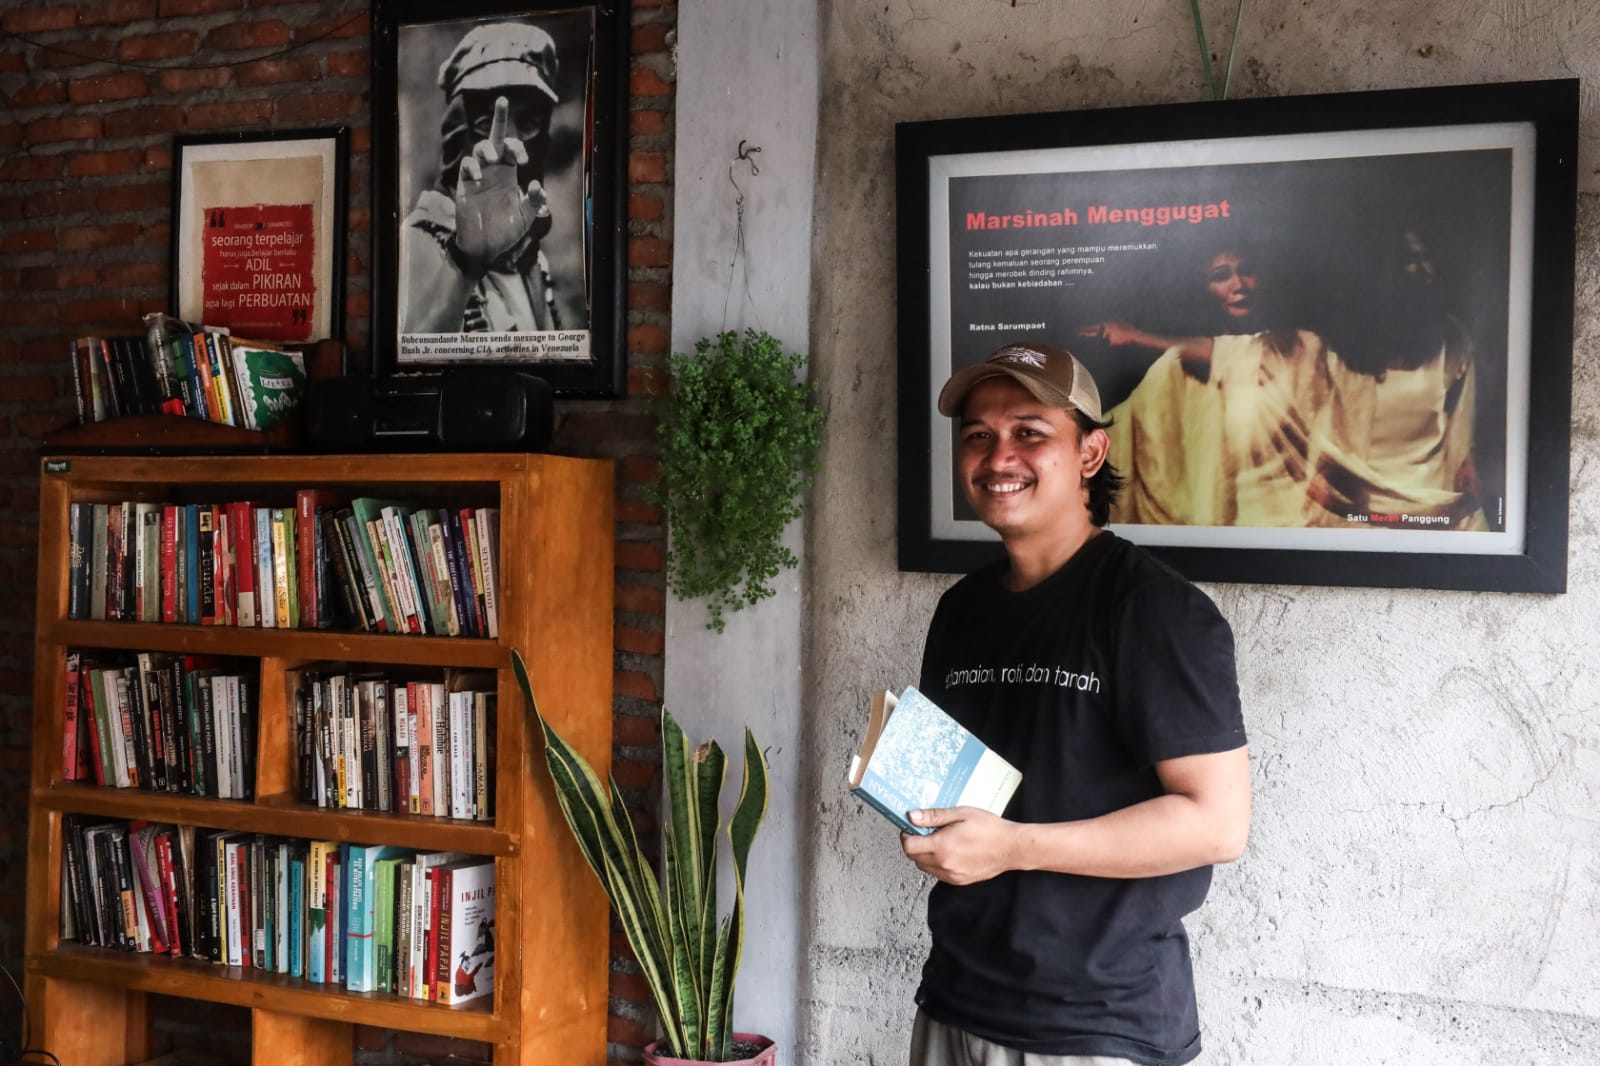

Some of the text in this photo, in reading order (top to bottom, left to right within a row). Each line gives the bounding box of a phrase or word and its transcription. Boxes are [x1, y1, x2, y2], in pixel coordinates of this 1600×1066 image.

[966, 199, 1231, 231] Marsinah Menggugat
[211, 232, 304, 248] seorang terpelajar
[969, 249, 1003, 258] Kekuatan
[1005, 249, 1019, 258] apa
[1057, 247, 1075, 255] yang
[1077, 245, 1106, 253] mampu
[245, 258, 272, 271] ADIL
[968, 256, 1105, 269] tulang kemaluan seorang perempuan
[211, 273, 301, 291] sejak dalam PIKIRAN
[968, 271, 993, 280] hingga
[995, 269, 1027, 279] merobek
[1029, 268, 1055, 278] dinding
[969, 281, 990, 290] kalau
[992, 280, 1016, 289] bukan
[1018, 279, 1062, 288] kebiadaban
[205, 293, 311, 310] apa lagi PERBUATAN
[969, 322, 1045, 331] Ratna Sarumpaet
[401, 335, 458, 344] Subcomandante
[460, 334, 488, 343] Marcos
[490, 334, 511, 342] sends
[513, 334, 546, 343] message
[558, 333, 586, 342] George
[401, 346, 421, 354] Bush
[422, 346, 433, 354] Jr.
[434, 346, 474, 355] concerning
[476, 345, 492, 353] CIA
[495, 344, 530, 353] activities
[541, 343, 579, 353] Venezuela
[1347, 513, 1450, 525] Satu Merah Panggung
[482, 546, 492, 573] SETAN
[486, 587, 494, 611] OYOT
[1025, 663, 1050, 683] dan
[436, 721, 446, 755] Habibie
[477, 761, 486, 797] SAMAN
[461, 887, 485, 903] INJIL
[440, 913, 450, 942] INJIL
[439, 944, 449, 977] PAPAT
